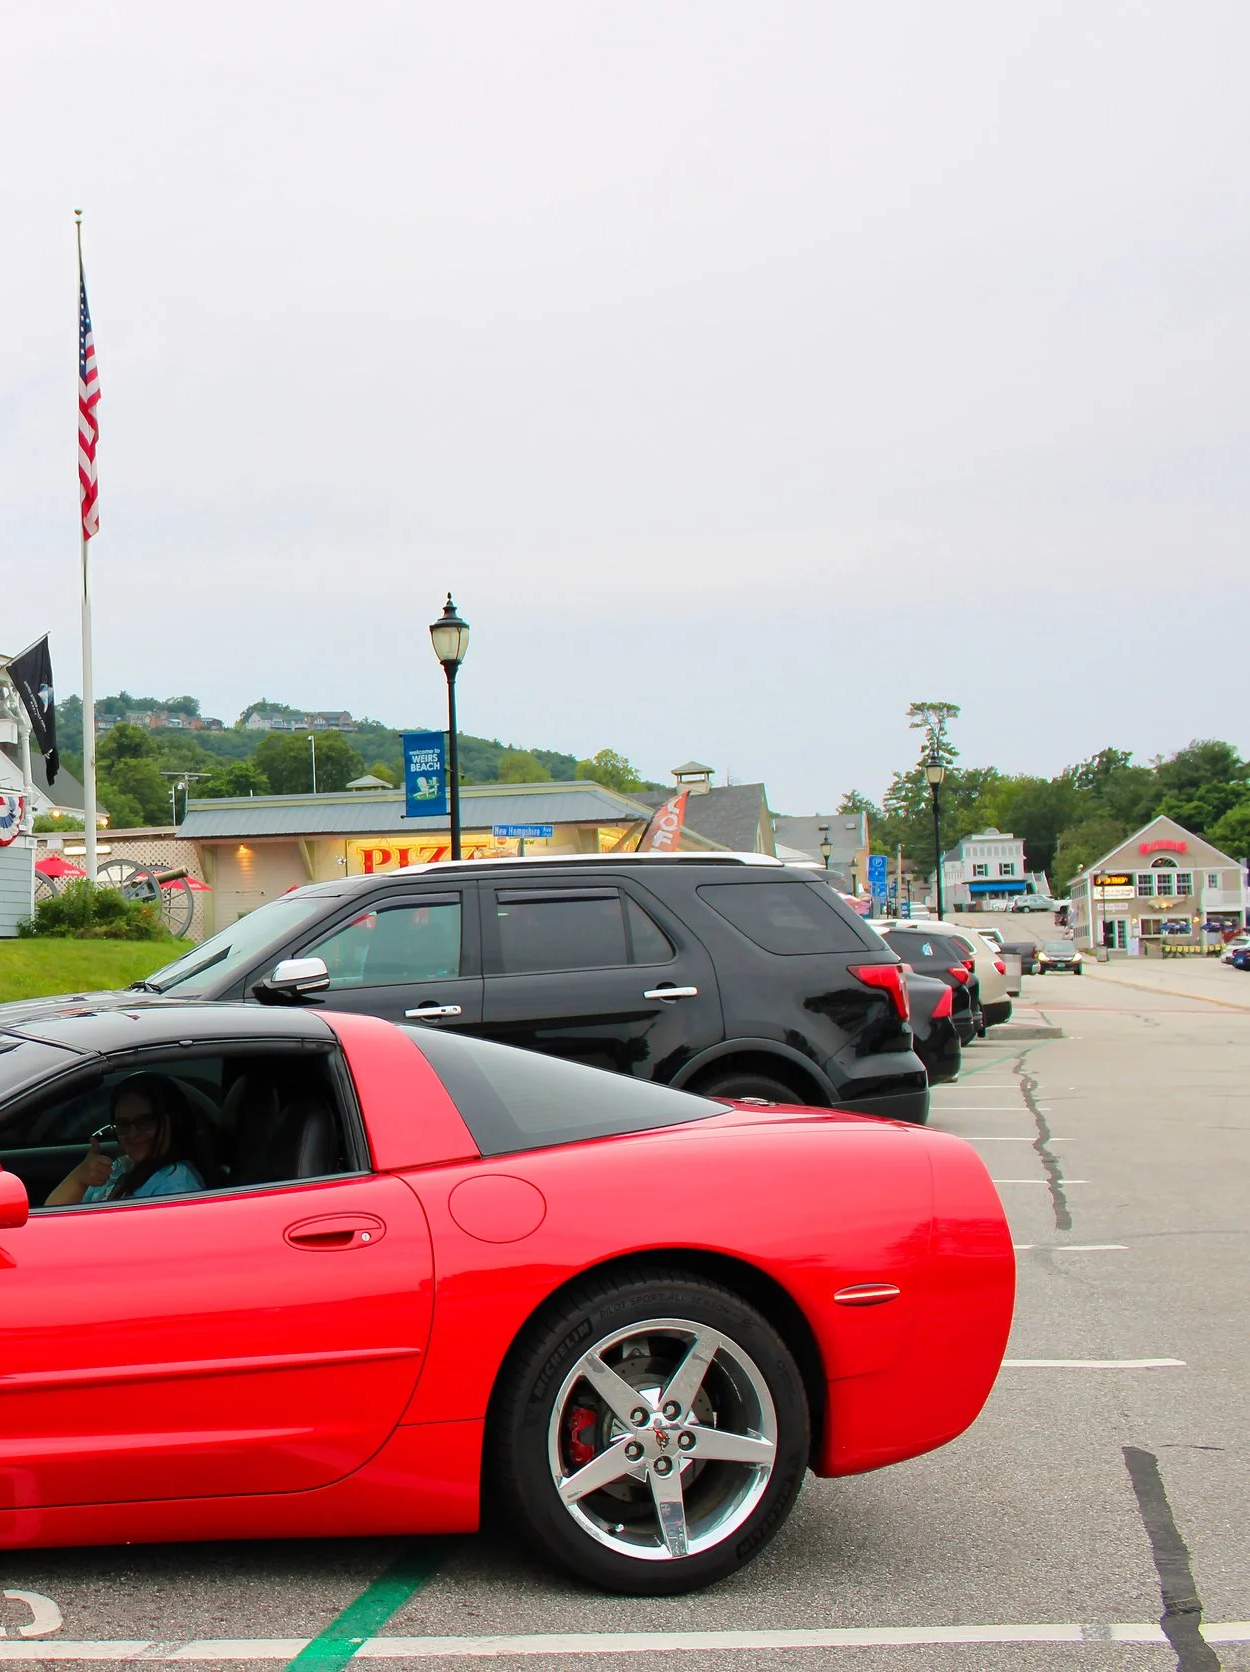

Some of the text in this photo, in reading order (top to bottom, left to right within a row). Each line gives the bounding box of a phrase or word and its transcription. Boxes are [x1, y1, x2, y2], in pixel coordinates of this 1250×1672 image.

[409, 748, 434, 756] welcome
[412, 753, 438, 764] WEIRS
[411, 762, 440, 773] BEACH
[494, 826, 508, 836] New
[508, 826, 541, 838] Hampshire
[630, 1293, 665, 1306] SPORT
[533, 1319, 593, 1398] MICHELIN
